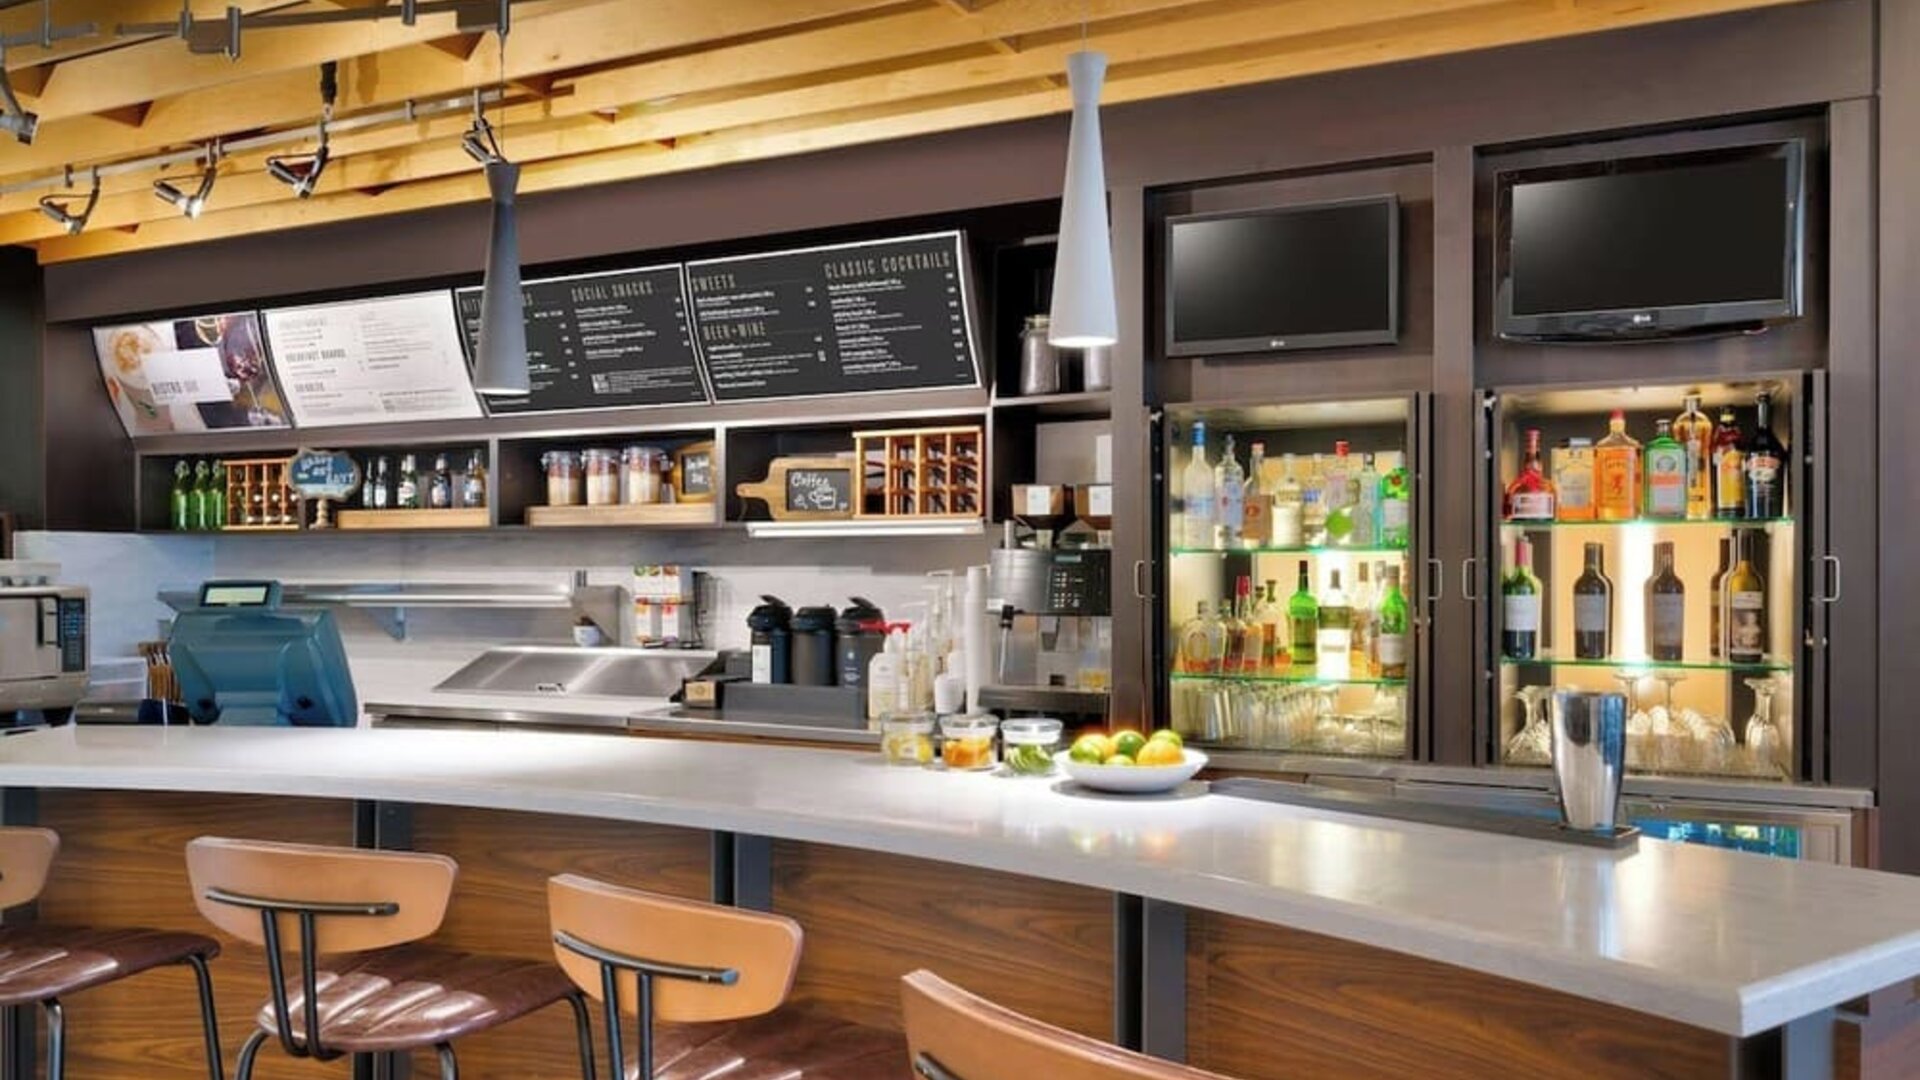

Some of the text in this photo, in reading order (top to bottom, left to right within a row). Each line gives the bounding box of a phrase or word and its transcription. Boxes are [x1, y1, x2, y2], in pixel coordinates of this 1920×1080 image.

[824, 251, 950, 279] CLASSIC COCKTAILS
[571, 280, 653, 303] SOCIAL SNACKS
[692, 274, 736, 293] SWEETS
